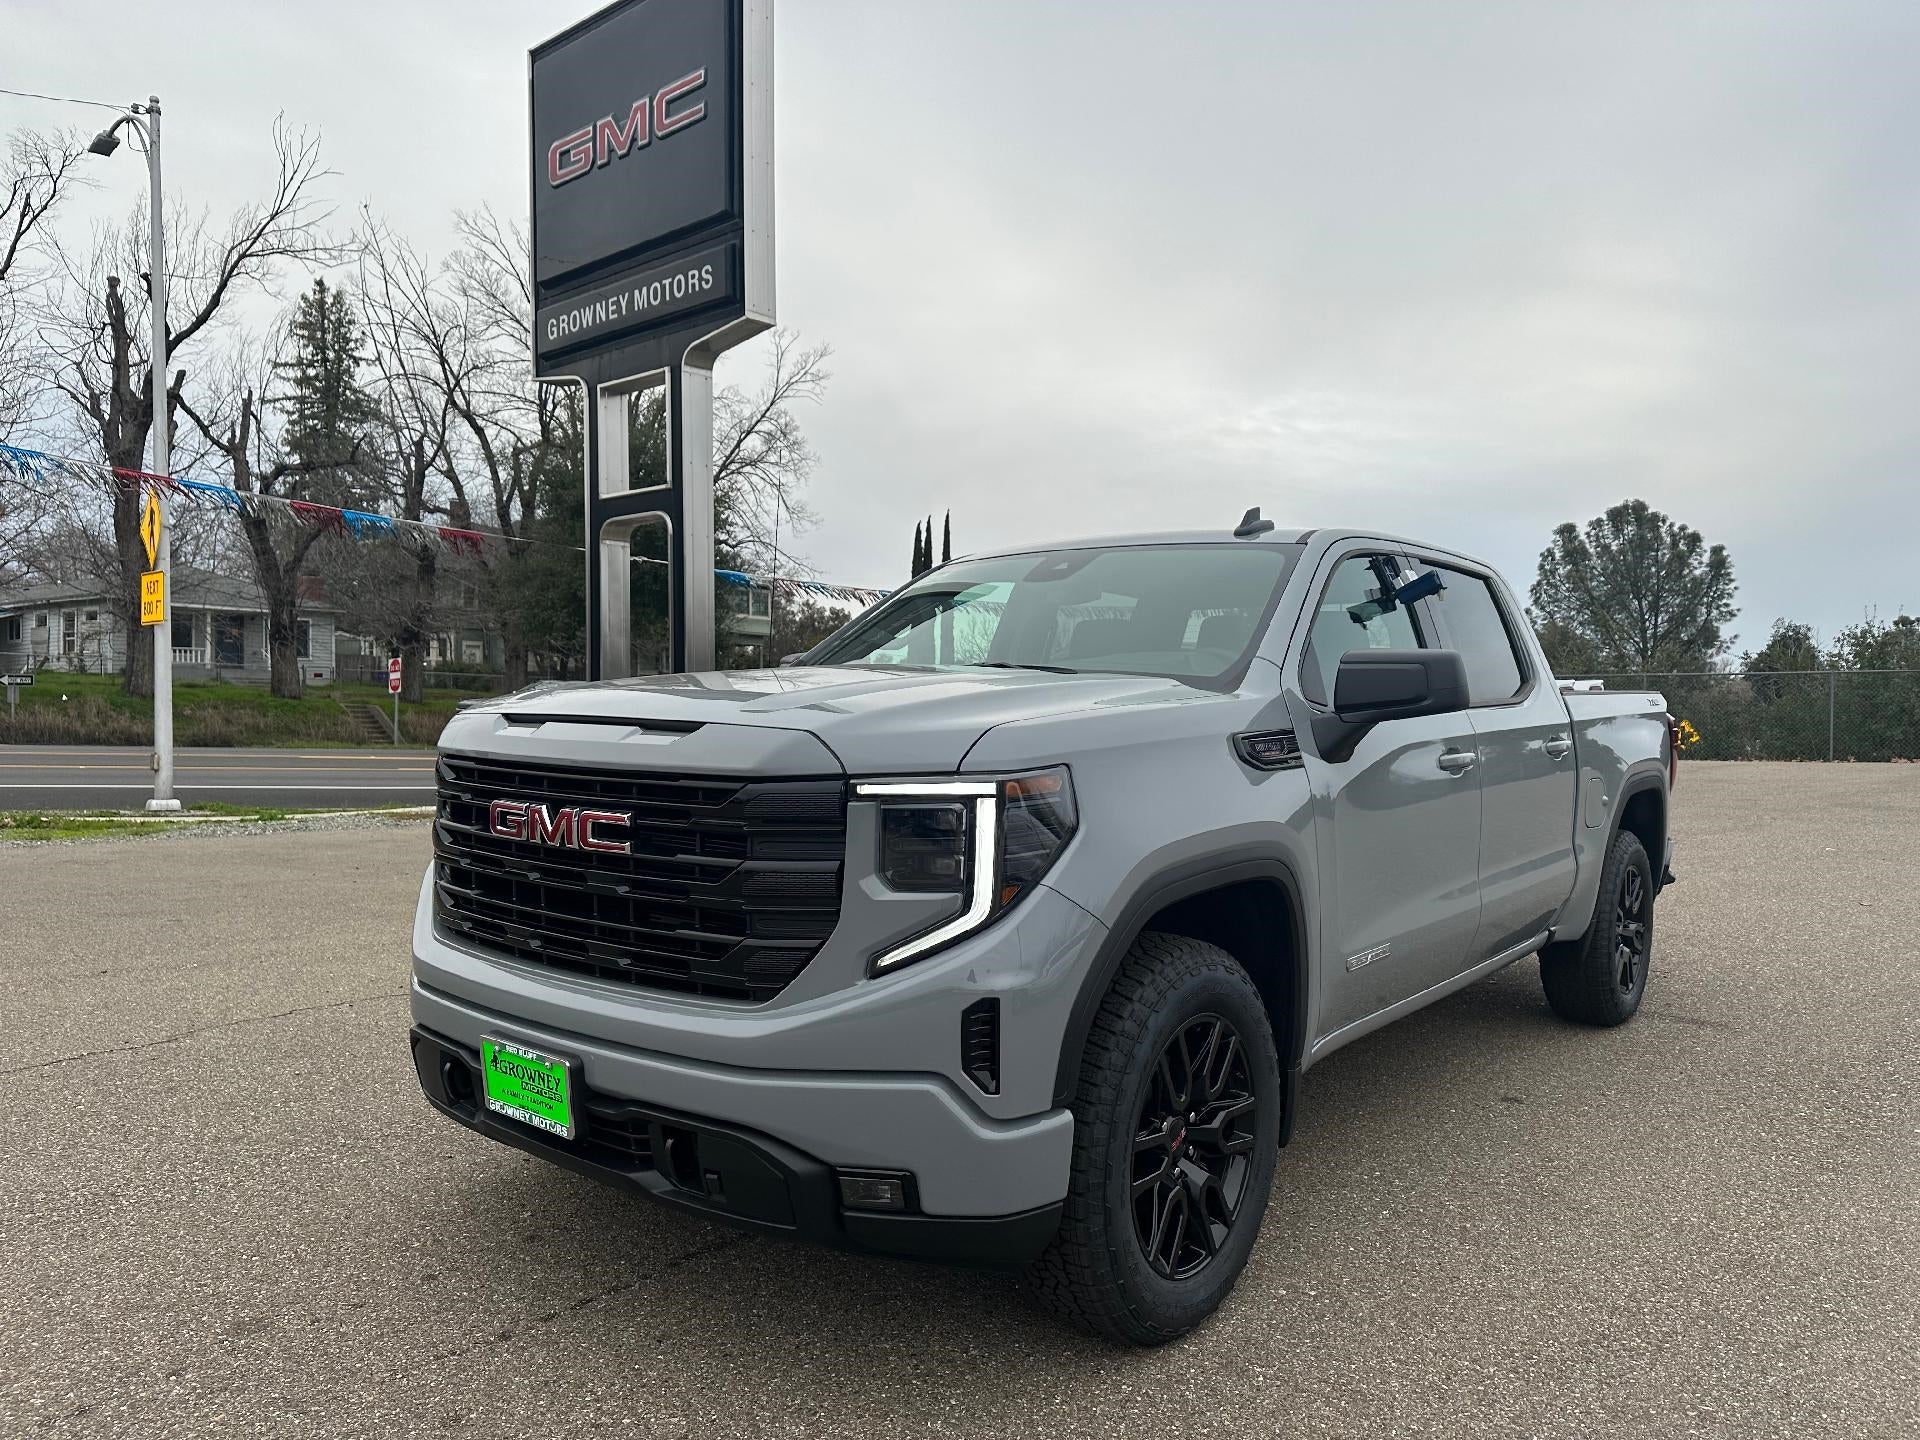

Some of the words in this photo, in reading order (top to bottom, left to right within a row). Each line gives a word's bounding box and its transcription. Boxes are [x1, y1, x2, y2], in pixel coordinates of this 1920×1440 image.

[548, 66, 707, 188] GMC
[547, 291, 630, 341] GROWNEY
[634, 264, 714, 312] MOTORS
[146, 580, 160, 596] NEXT
[490, 799, 632, 855] GMC
[499, 1059, 561, 1093] GROWNEY
[522, 1082, 563, 1103] MOTORS
[489, 1099, 531, 1122] GROWNEY
[532, 1114, 568, 1137] MOTORS
